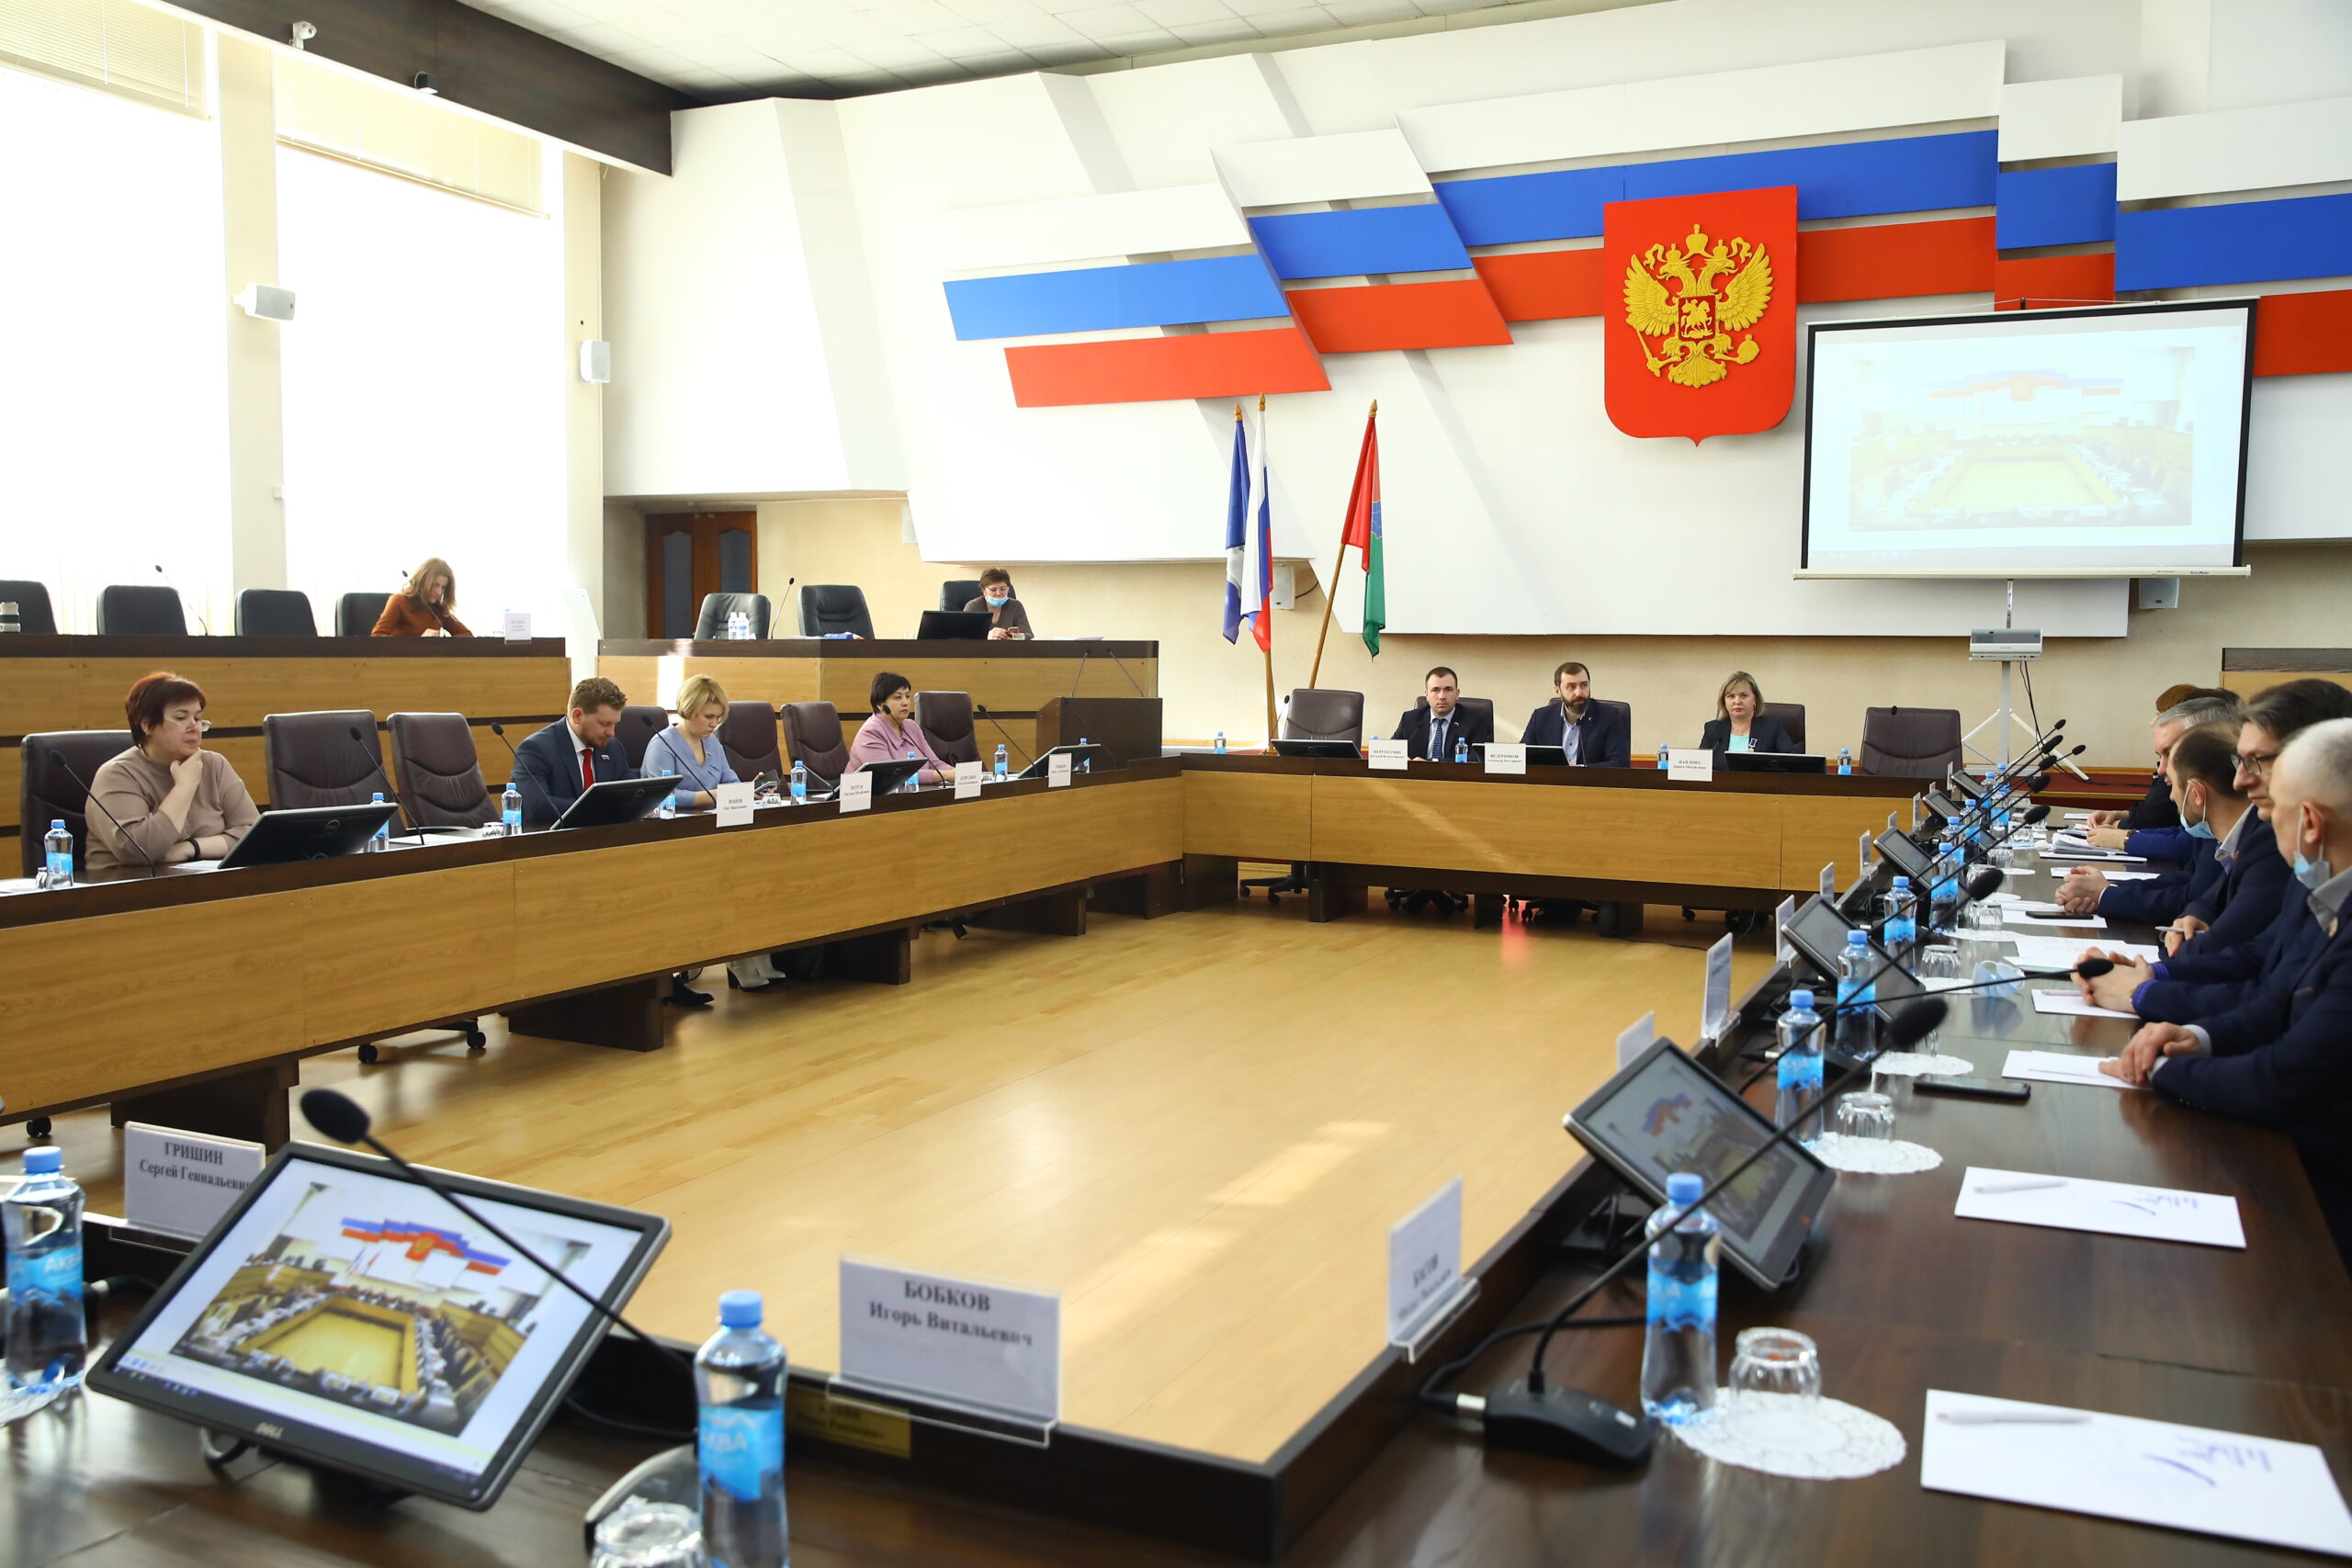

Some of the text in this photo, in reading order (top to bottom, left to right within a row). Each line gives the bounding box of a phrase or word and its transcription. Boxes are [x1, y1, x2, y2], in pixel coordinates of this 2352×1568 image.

[164, 1142, 223, 1165] ГРИШИН
[140, 1158, 177, 1178] Сергей
[903, 1280, 991, 1312] БОБКОВ
[869, 1301, 1033, 1347] Игорь Витальевич
